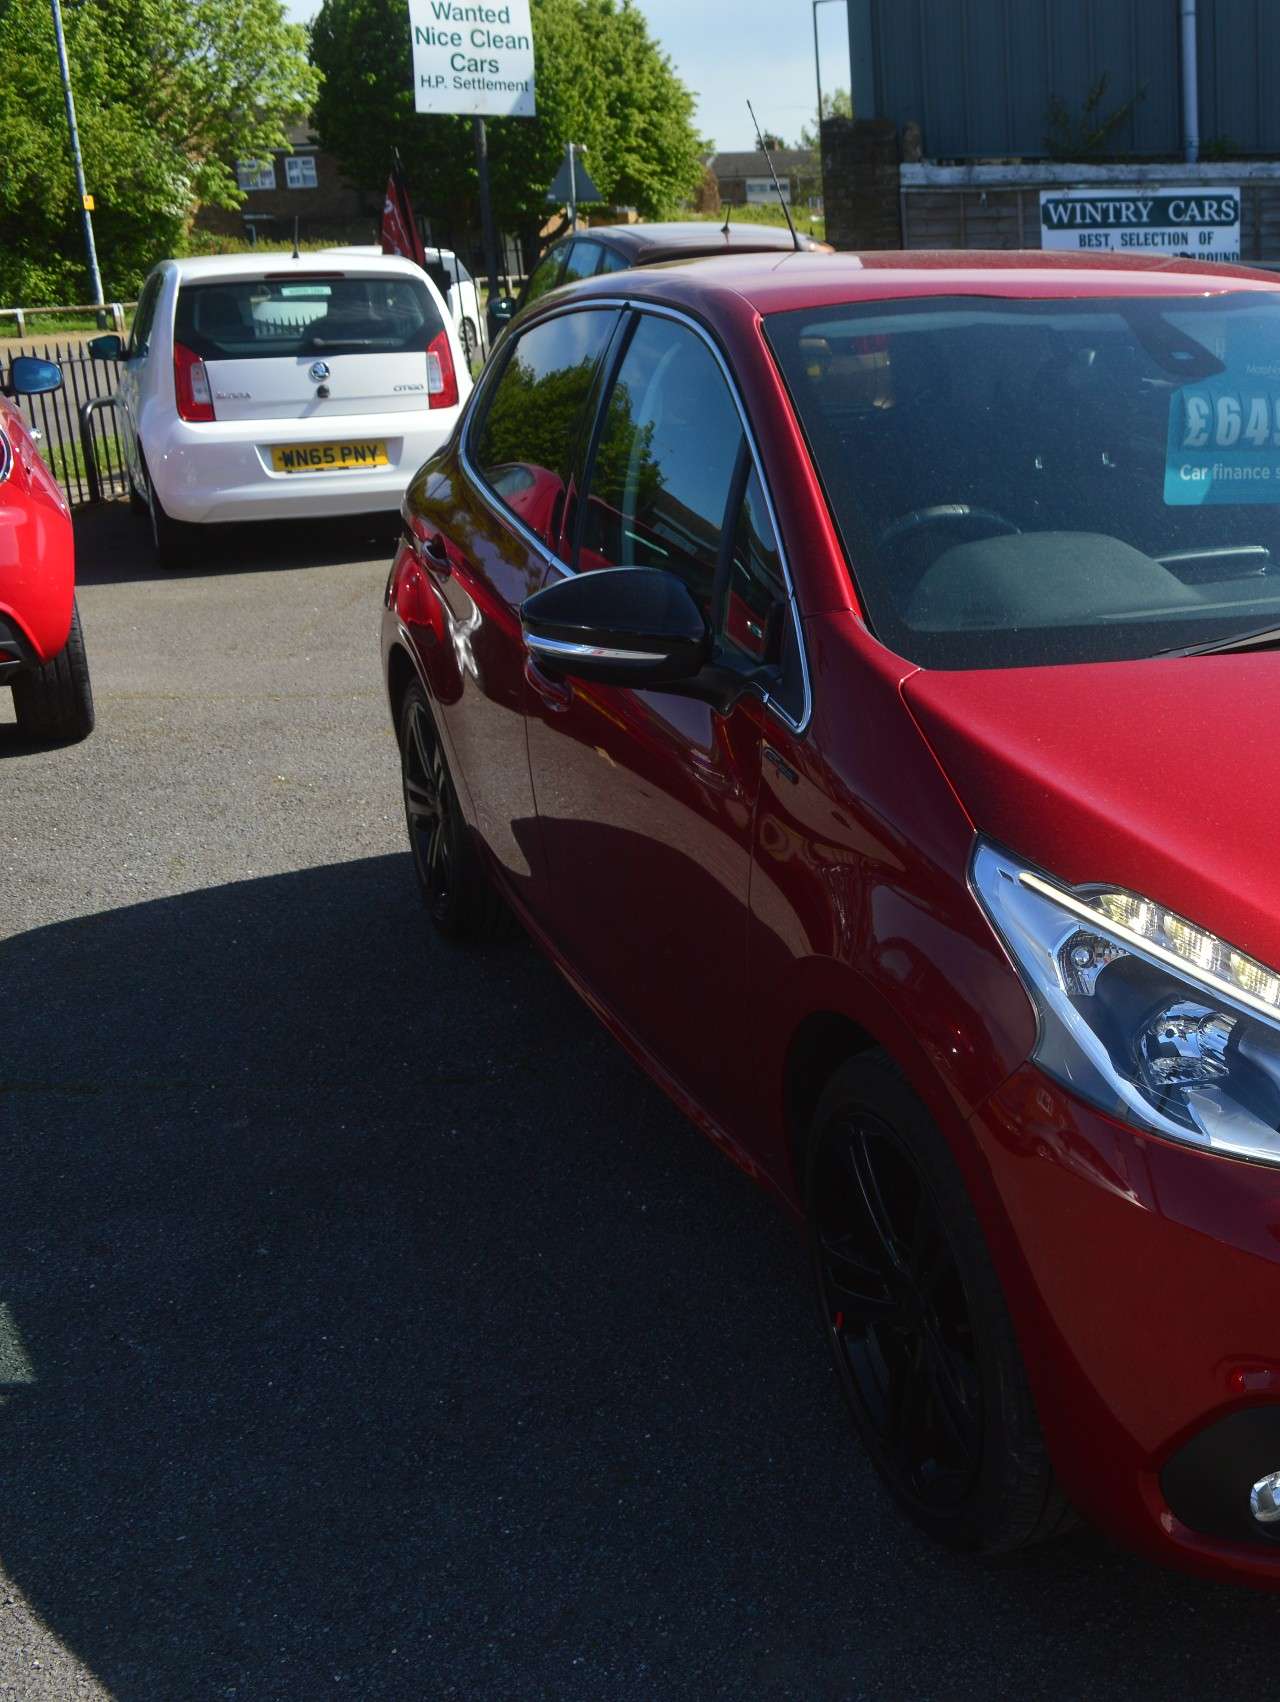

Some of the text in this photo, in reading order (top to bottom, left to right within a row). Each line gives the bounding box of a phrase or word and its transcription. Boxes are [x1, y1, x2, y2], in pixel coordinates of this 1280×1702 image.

[431, 1, 511, 25] Wanted
[414, 26, 530, 50] Nice Clean
[450, 53, 500, 74] Cars
[420, 75, 529, 92] H.P. Settlement
[1047, 199, 1235, 224] WINTRY CARS
[1078, 231, 1214, 248] BEST SELECTION OF
[281, 445, 379, 469] WN65 PNY
[1179, 464, 1208, 481] Car
[1212, 463, 1270, 480] finance
